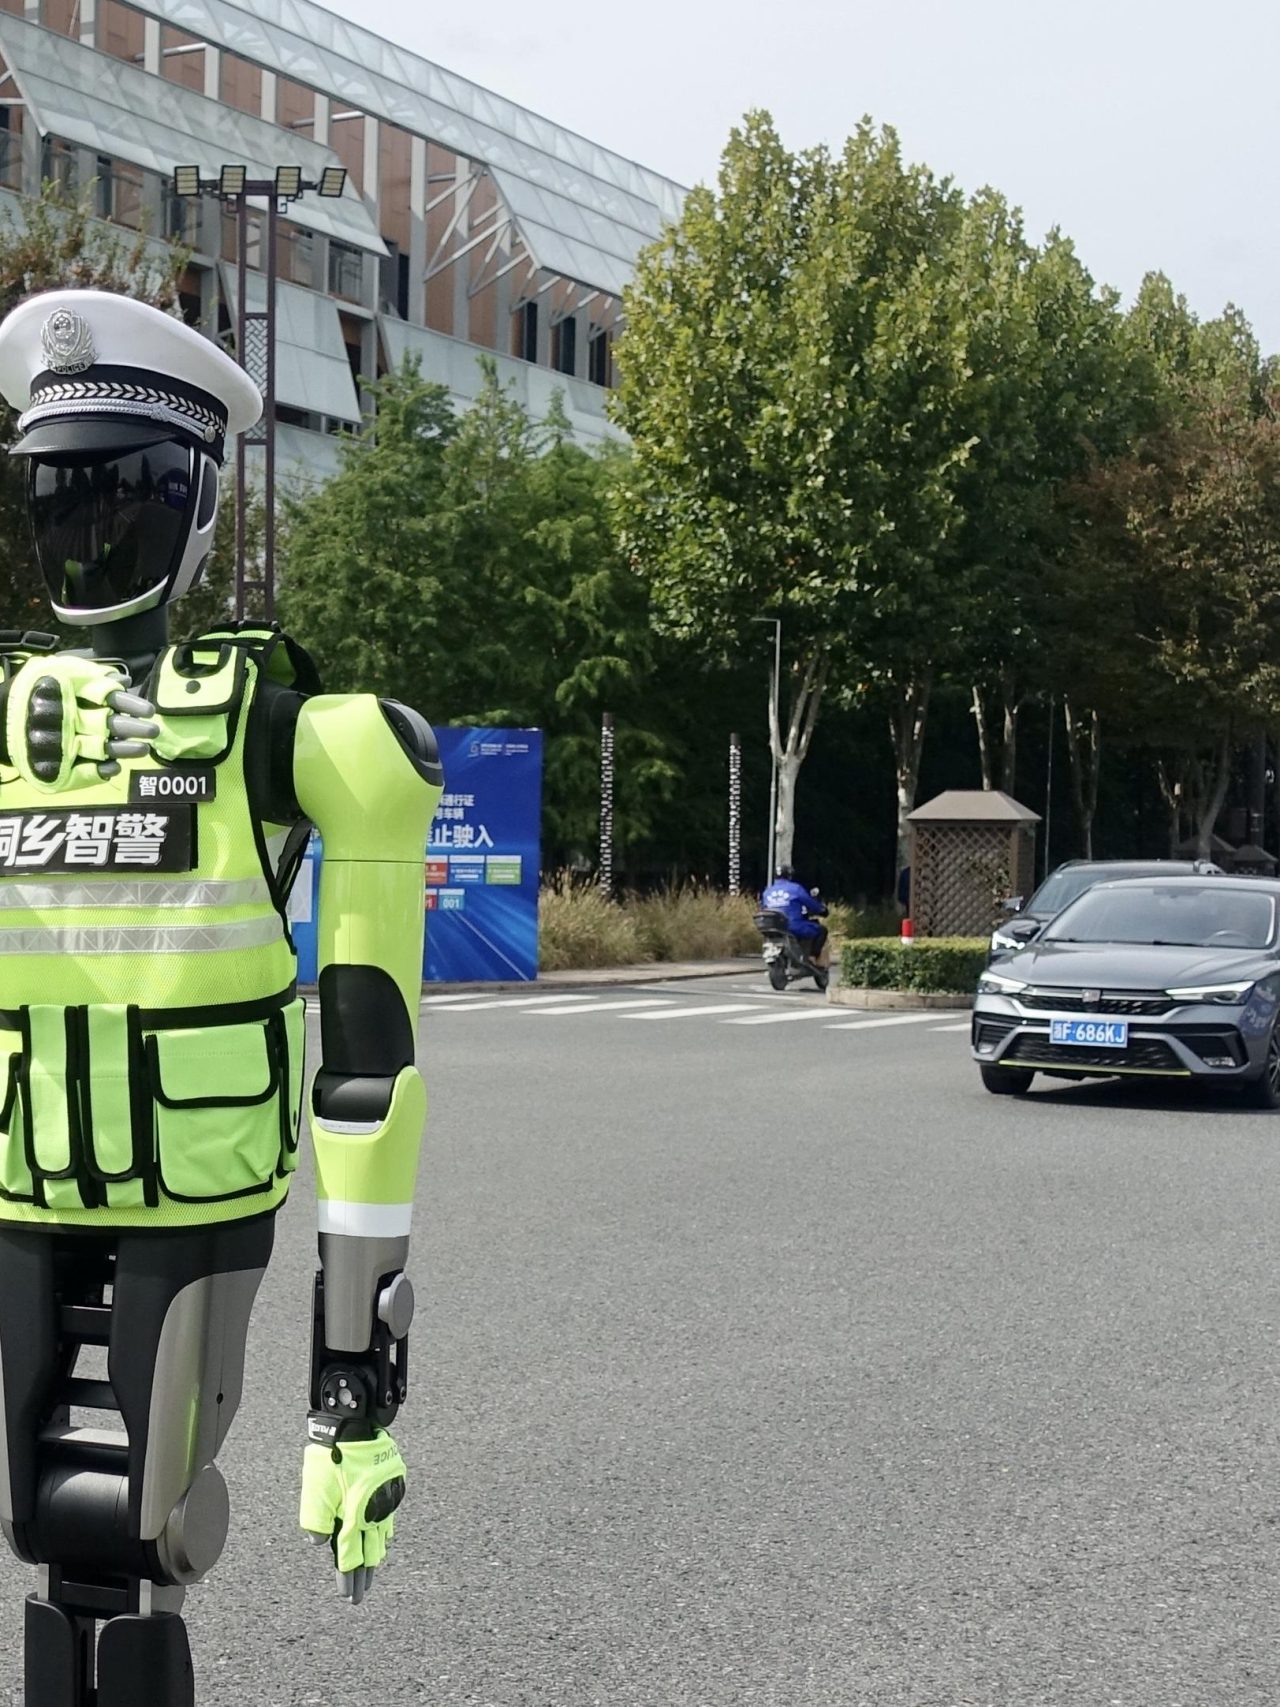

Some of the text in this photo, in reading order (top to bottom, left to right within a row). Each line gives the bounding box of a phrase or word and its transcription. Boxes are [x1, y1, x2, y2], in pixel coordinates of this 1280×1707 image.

[138, 775, 207, 797] 智0001
[427, 823, 494, 849] 止驶入
